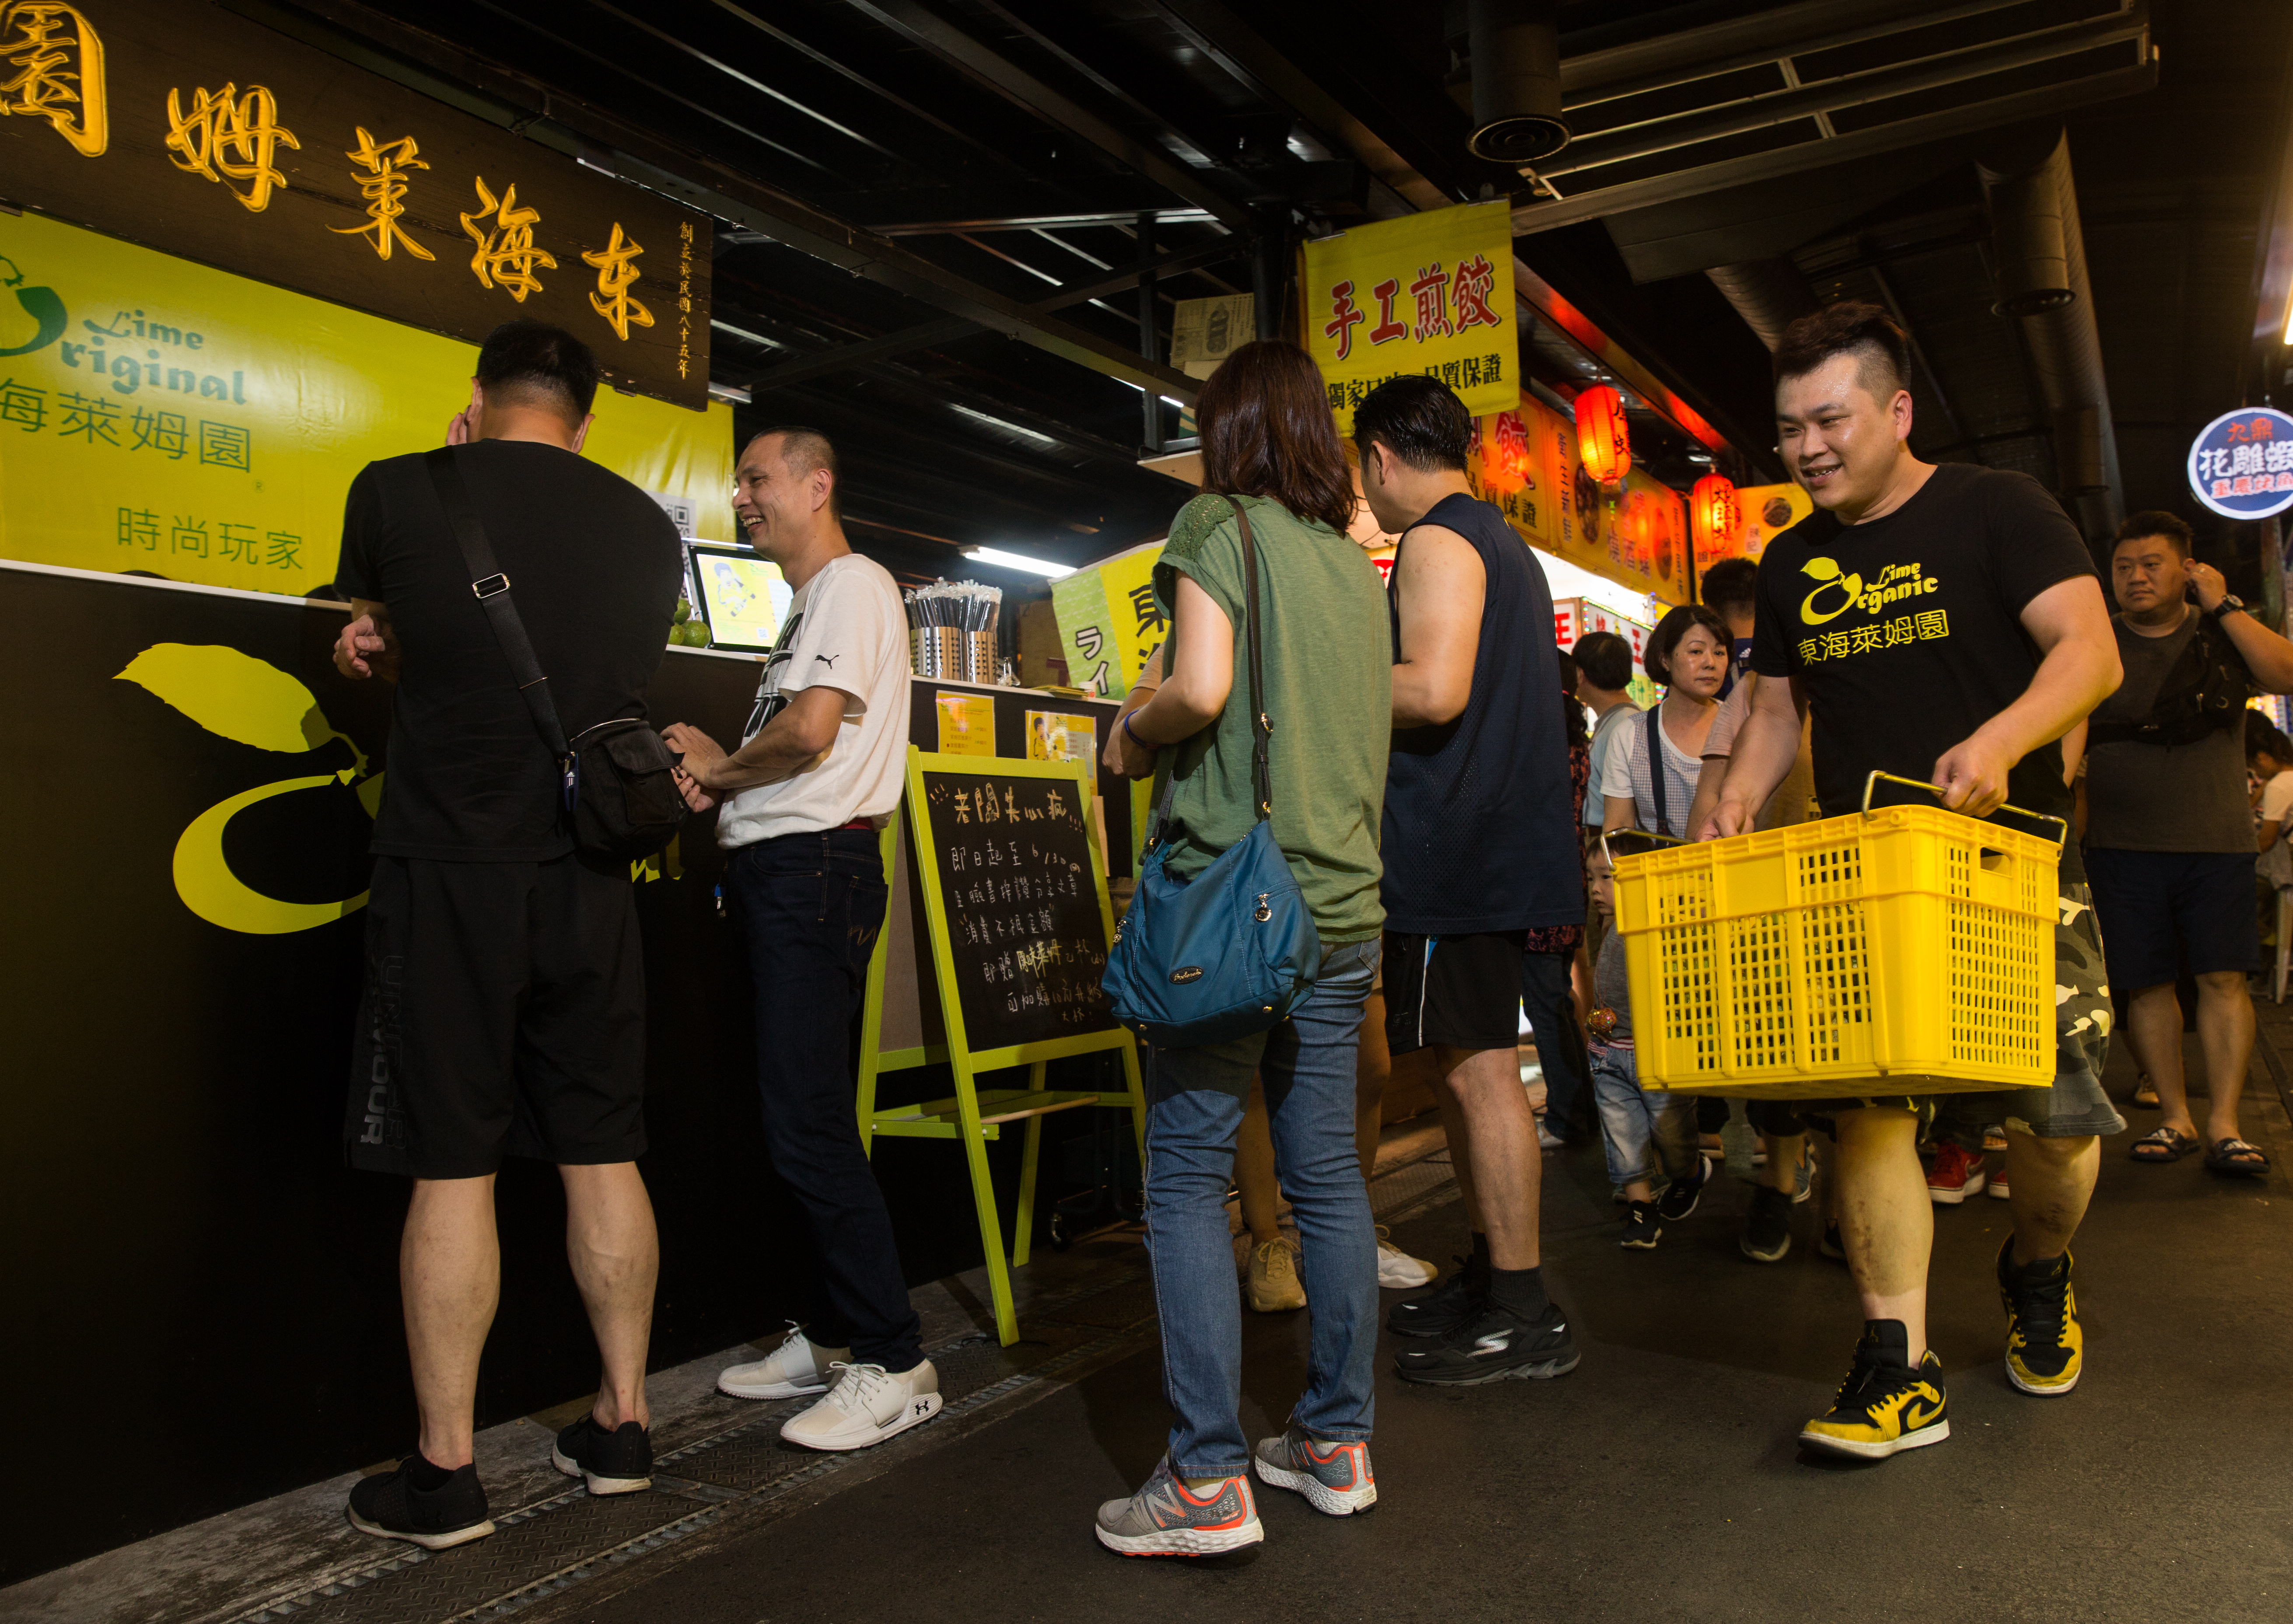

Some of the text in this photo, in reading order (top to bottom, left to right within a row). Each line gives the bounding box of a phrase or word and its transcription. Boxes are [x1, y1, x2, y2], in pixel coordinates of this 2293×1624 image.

[83, 308, 204, 350] Lime
[1324, 253, 1502, 361] 手工煎餃
[117, 506, 304, 570] 時尚玩家
[1865, 562, 1921, 592] Lime
[1797, 609, 1950, 666] 東海萊姆園
